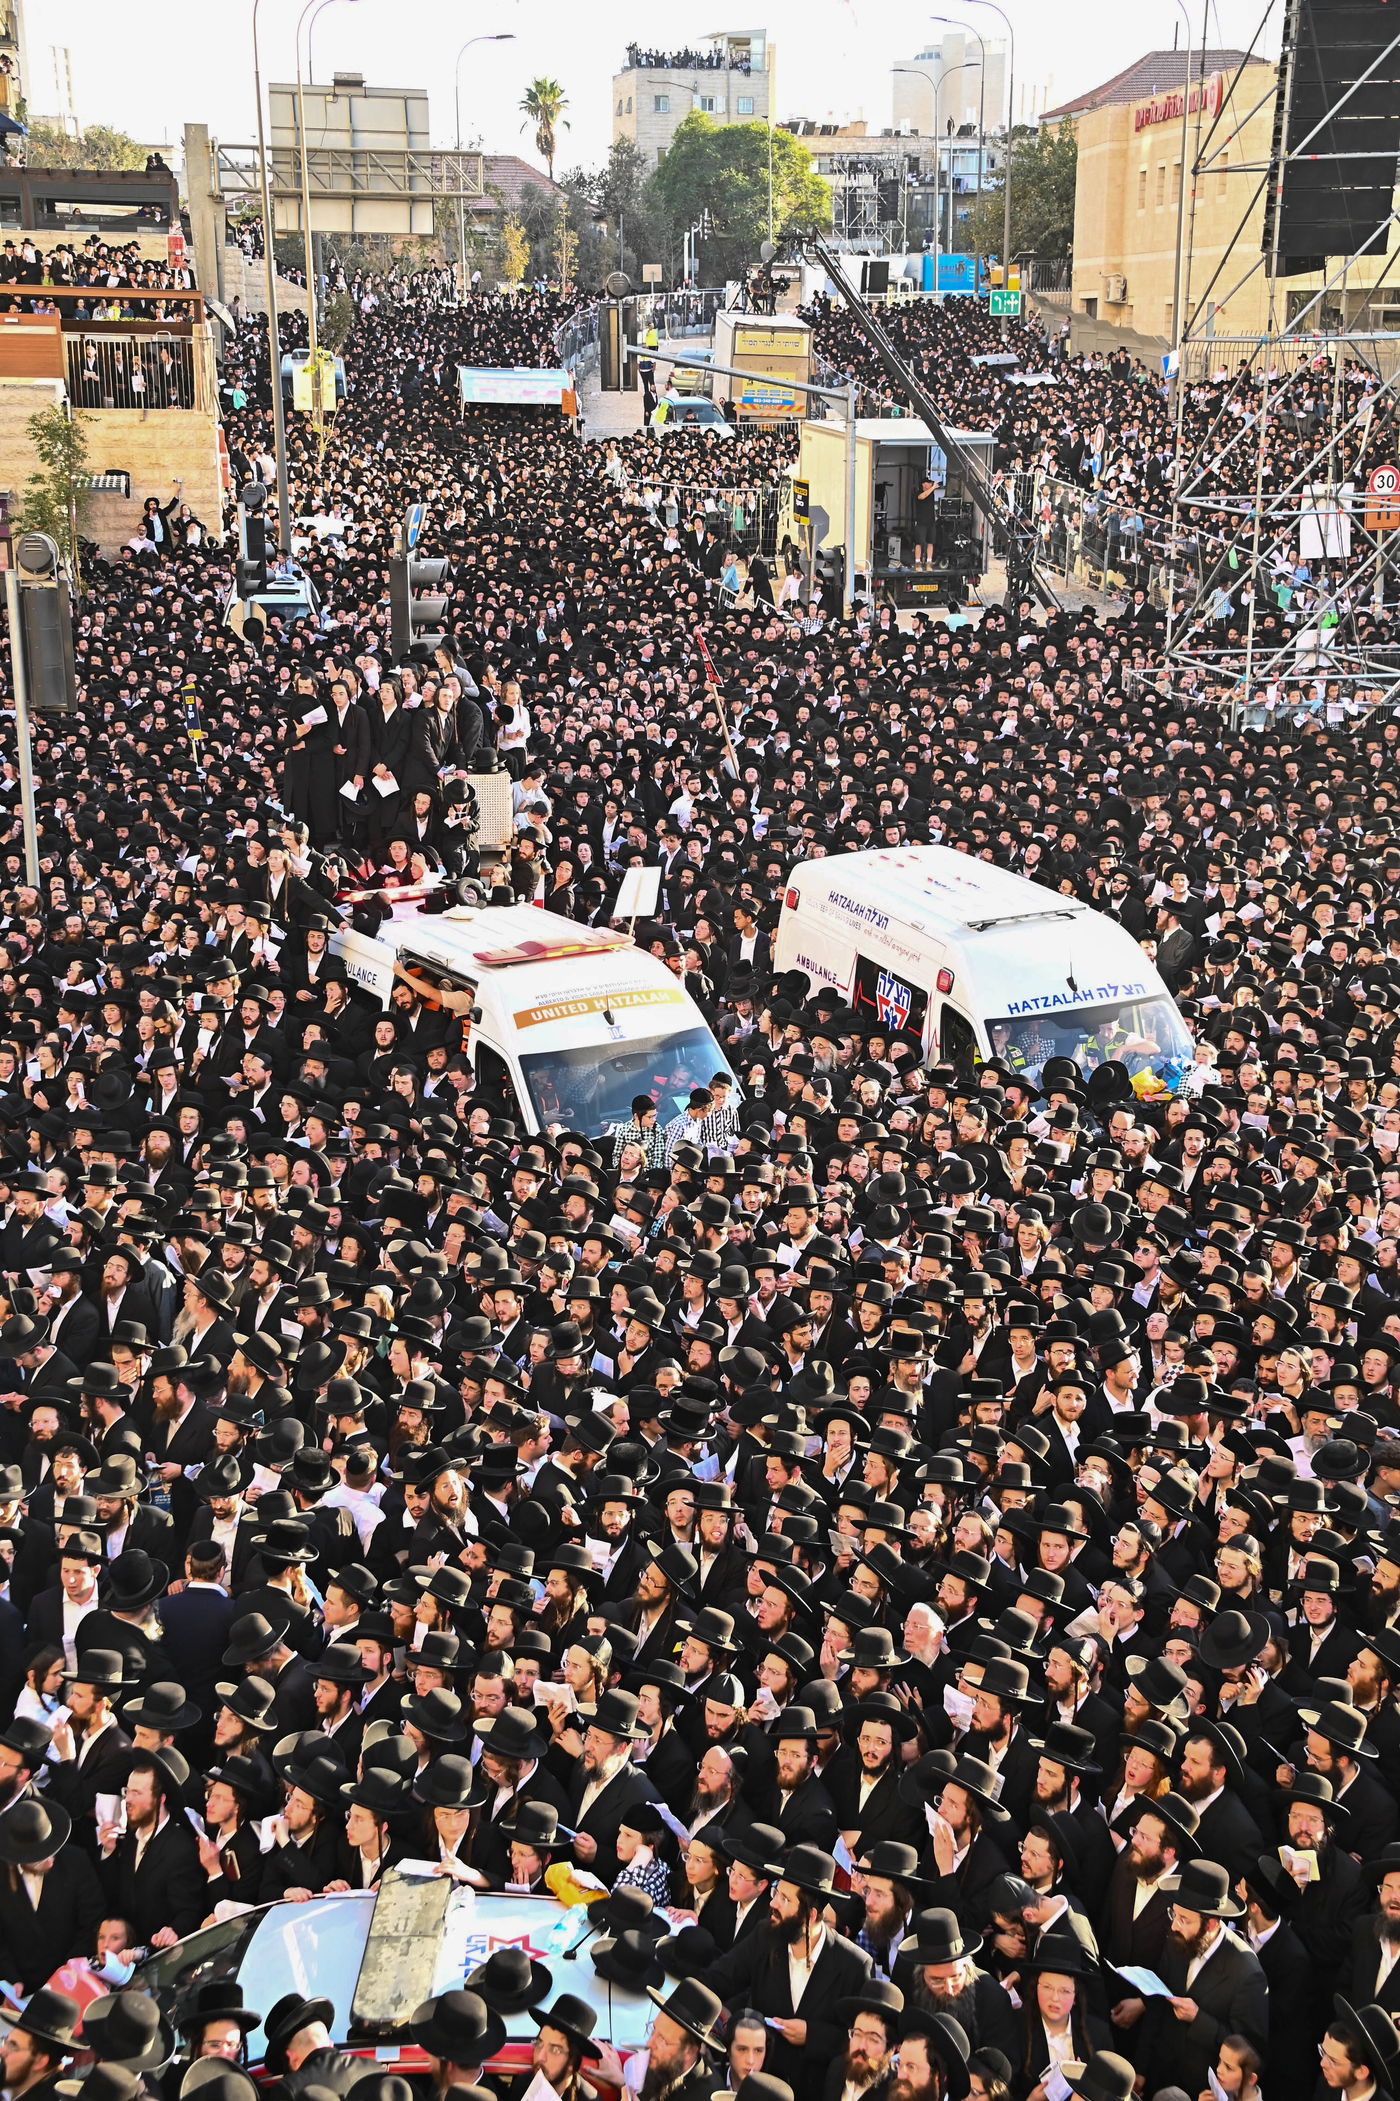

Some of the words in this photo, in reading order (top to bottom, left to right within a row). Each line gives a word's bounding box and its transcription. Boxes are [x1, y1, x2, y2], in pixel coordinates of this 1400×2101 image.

[1376, 474, 1395, 489] 30
[828, 890, 865, 918] HATZALAH
[864, 908, 889, 930] הצלה
[796, 953, 837, 985] AMBULANCE
[530, 1001, 588, 1022] UNITED
[594, 991, 671, 1011] HATZALAH
[878, 970, 911, 1011] הצלה
[1007, 989, 1095, 1015] HATZALAH
[1096, 983, 1147, 998] הצלה
